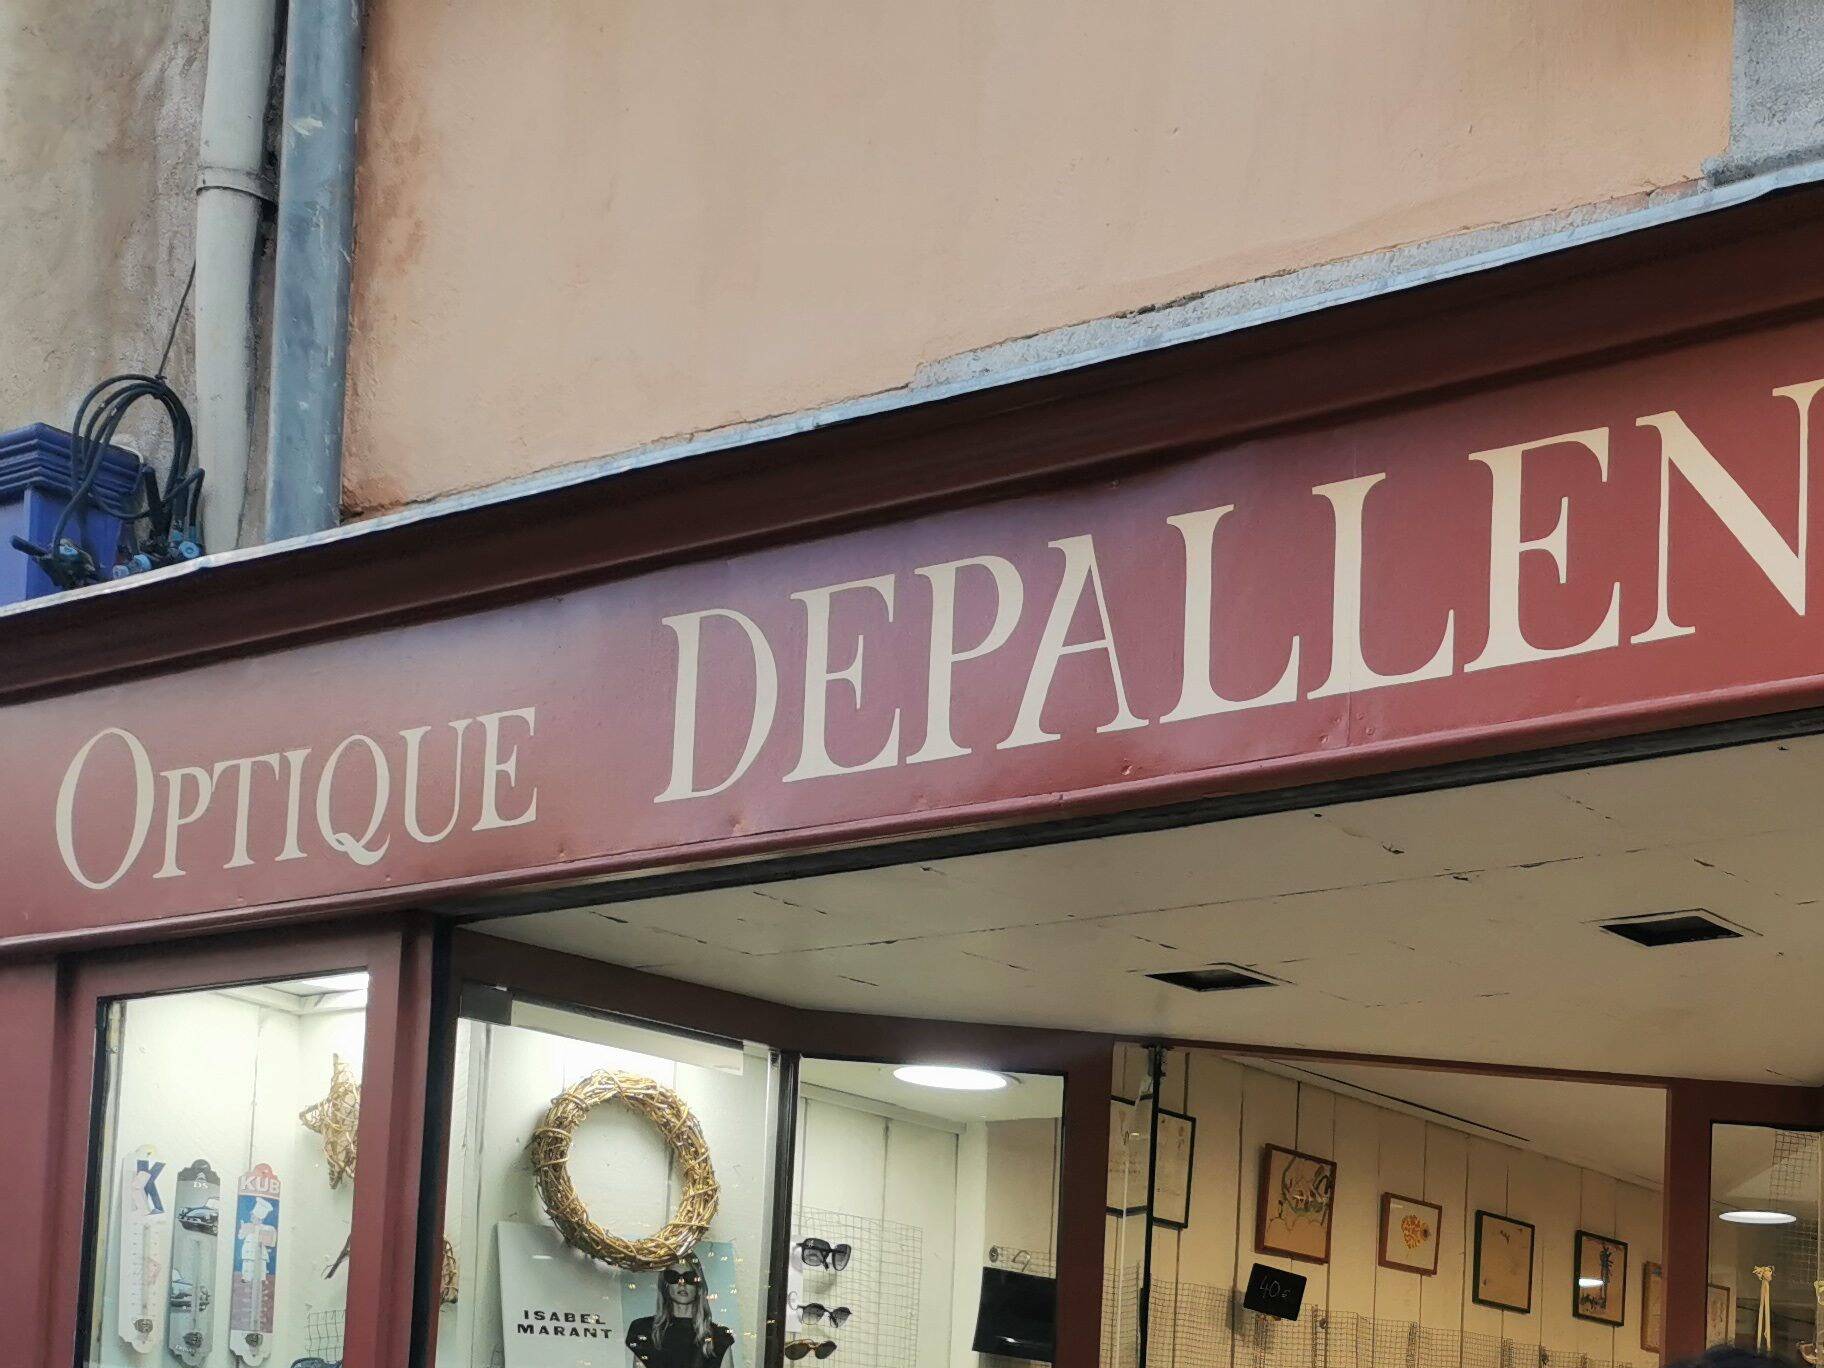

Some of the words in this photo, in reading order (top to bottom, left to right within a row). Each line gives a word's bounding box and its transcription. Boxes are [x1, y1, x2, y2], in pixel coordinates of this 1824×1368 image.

[56, 706, 538, 890] OPTIQUE
[239, 1175, 281, 1194] KUB
[523, 1309, 606, 1325] ISABEL
[517, 1324, 613, 1339] MARANT
